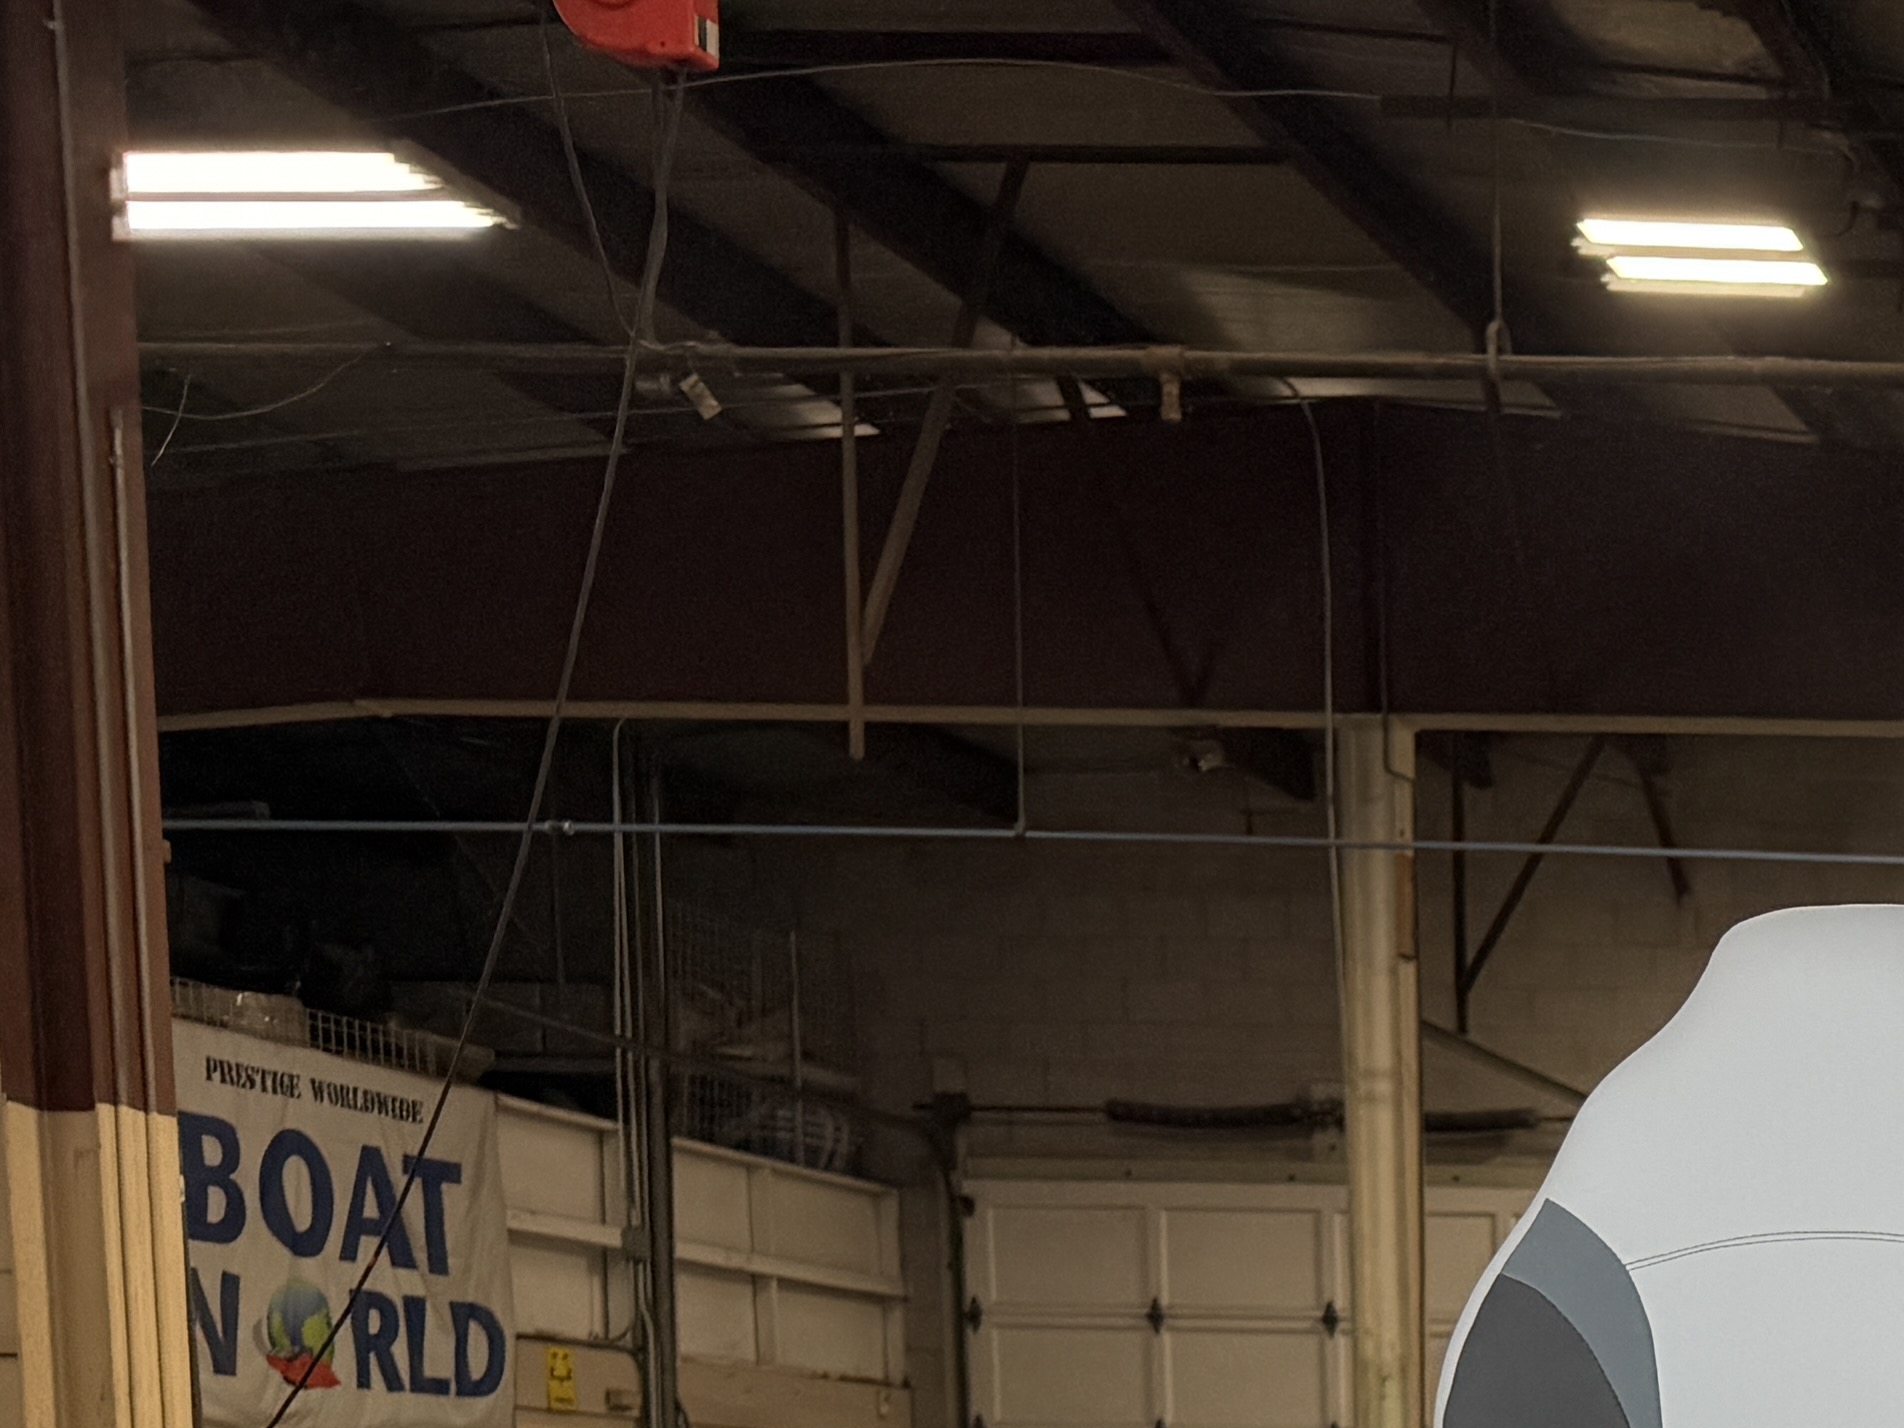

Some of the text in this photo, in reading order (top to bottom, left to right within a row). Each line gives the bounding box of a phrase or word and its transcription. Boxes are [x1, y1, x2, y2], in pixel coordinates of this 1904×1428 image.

[205, 1056, 424, 1124] PRESTIGE WORLDWIDE
[177, 1110, 462, 1276] BOAT
